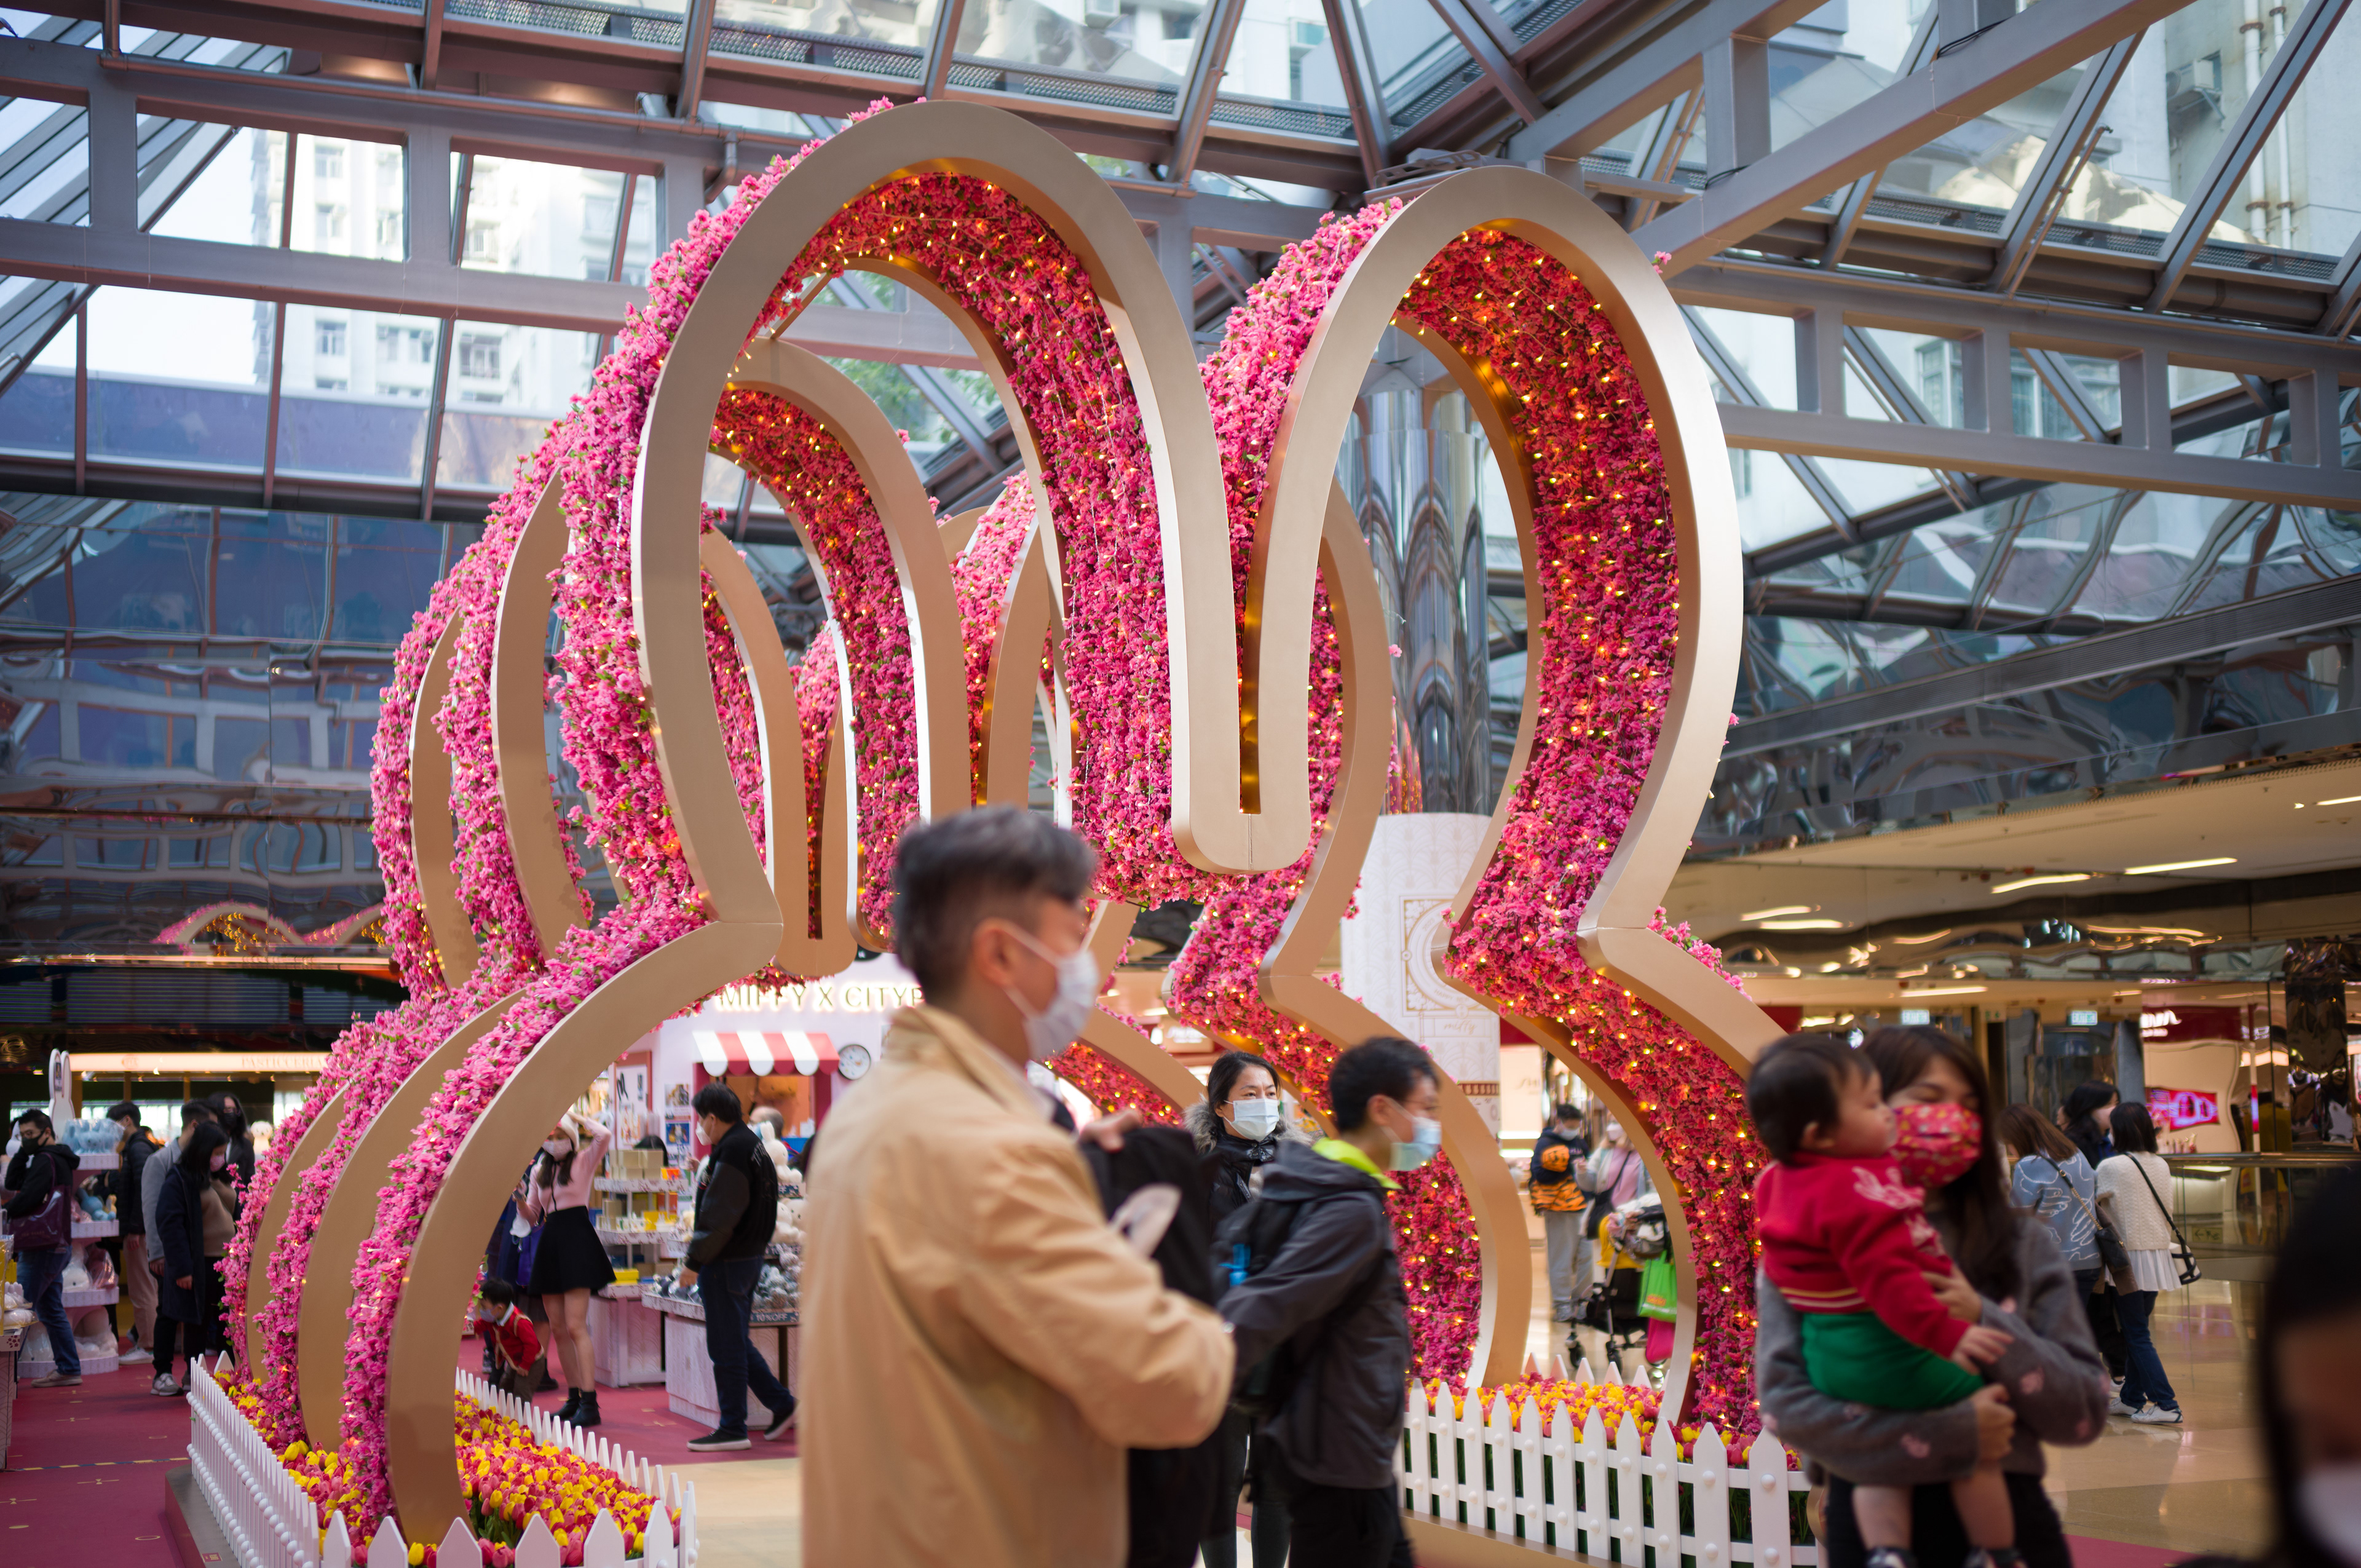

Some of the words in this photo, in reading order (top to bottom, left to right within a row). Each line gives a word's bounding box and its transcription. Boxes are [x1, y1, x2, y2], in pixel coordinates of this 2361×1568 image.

[721, 987, 806, 1006] MIFY
[819, 986, 832, 1007] X
[1434, 988, 1453, 1000] HAPPY
[1444, 1020, 1476, 1034] miffy
[241, 1055, 325, 1069] PASTICCERIA
